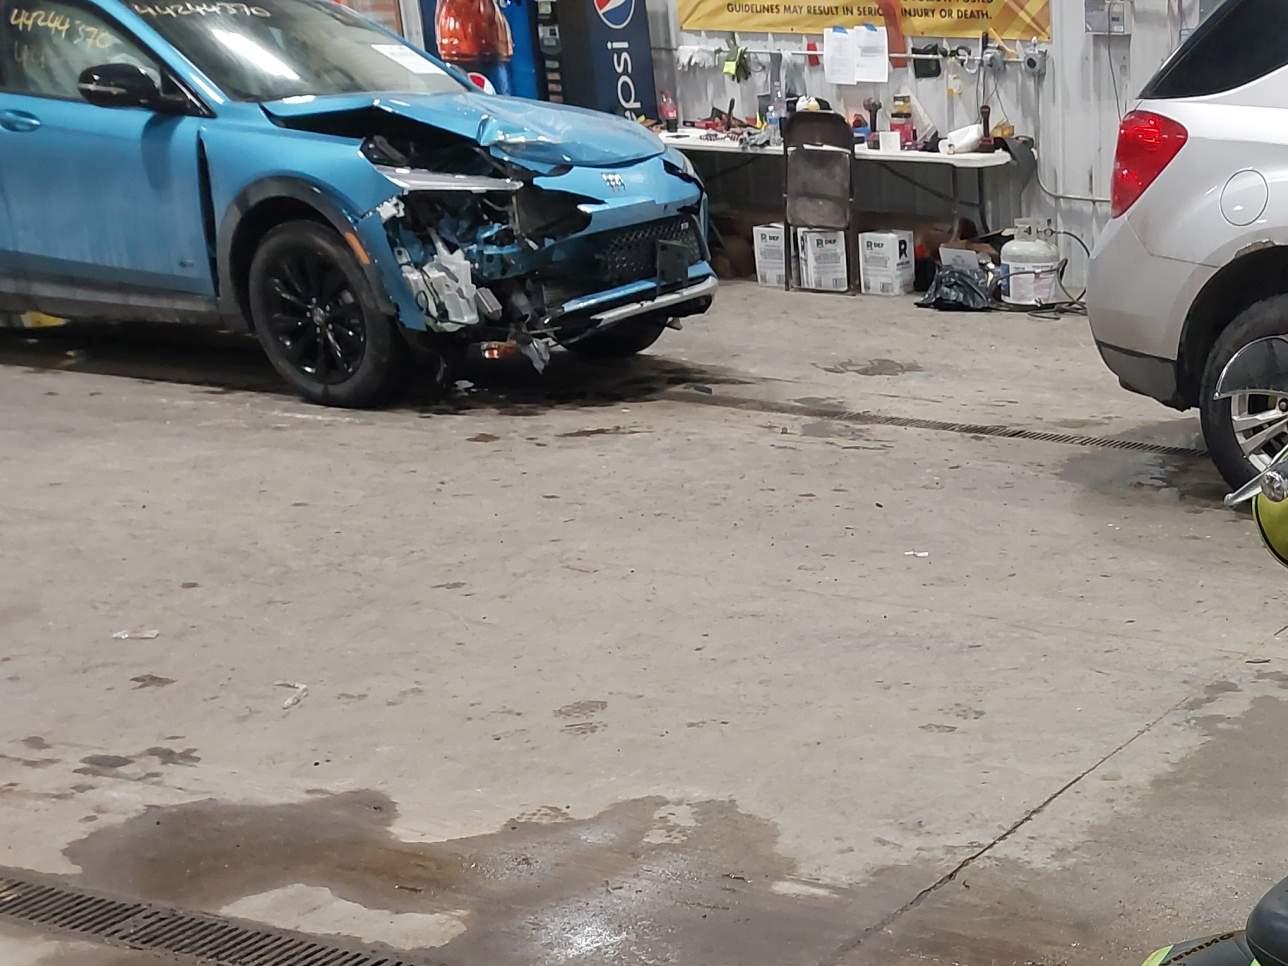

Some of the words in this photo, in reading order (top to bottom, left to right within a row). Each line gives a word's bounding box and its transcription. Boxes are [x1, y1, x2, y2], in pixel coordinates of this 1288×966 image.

[726, 3, 780, 14] GUIDELINES
[783, 4, 803, 15] MAY
[806, 5, 839, 16] RESULT
[842, 6, 854, 16] IN
[856, 6, 885, 17] SERIO
[901, 8, 936, 18] INJURY
[939, 8, 953, 18] OR
[956, 8, 992, 20] DEATH.
[606, 41, 641, 120] psi
[898, 239, 908, 260] R
